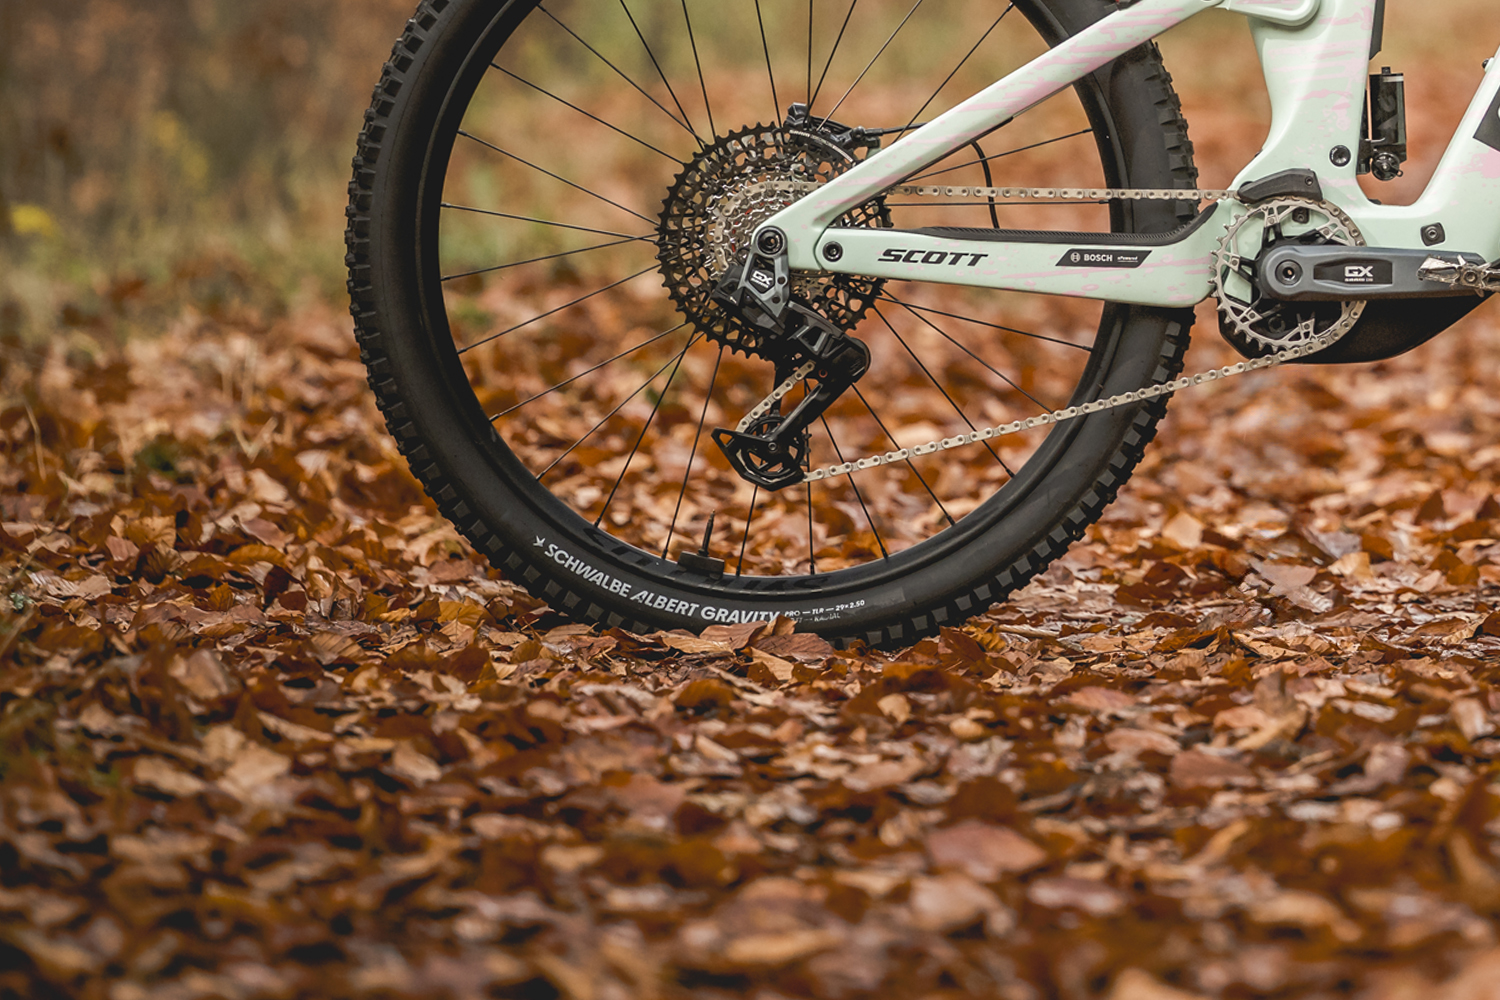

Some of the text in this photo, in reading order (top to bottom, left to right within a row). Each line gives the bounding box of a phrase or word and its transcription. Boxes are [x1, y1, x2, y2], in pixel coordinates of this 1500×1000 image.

[877, 248, 989, 267] SCOTT
[1083, 253, 1113, 262] BOSCH
[752, 270, 773, 285] GX
[1344, 265, 1373, 277] GX
[544, 543, 632, 598] SCHWALBE
[630, 590, 699, 617] ALBERT
[701, 606, 780, 624] GRAVITY
[812, 607, 824, 615] TLR
